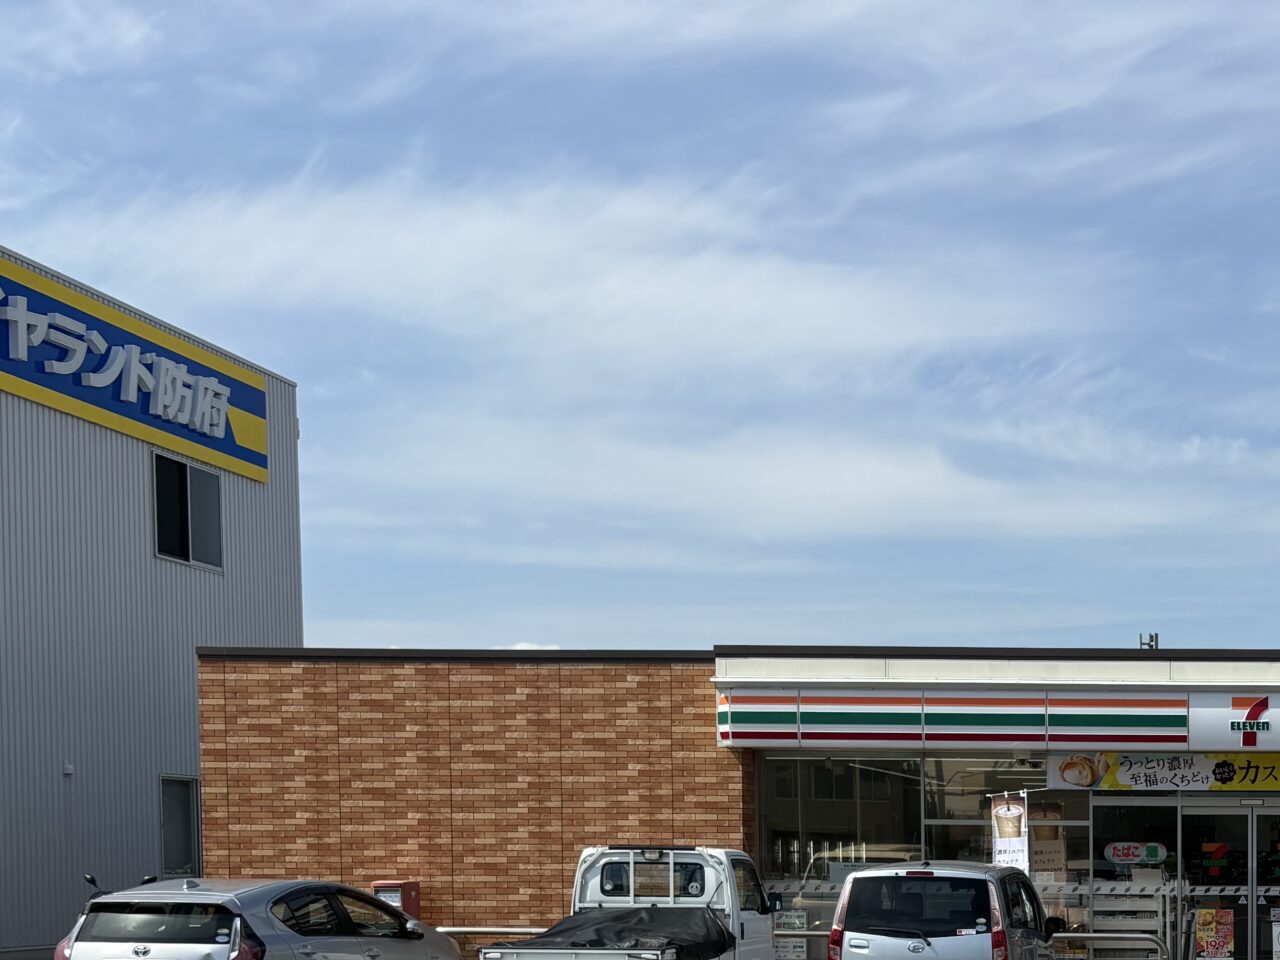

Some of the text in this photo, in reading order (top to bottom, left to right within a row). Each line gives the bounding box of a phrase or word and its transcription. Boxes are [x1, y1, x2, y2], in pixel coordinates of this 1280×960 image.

[0, 286, 231, 439] ヤランド防府
[1120, 756, 1196, 772] うっとり濃厚
[1130, 771, 1210, 788] 至福のくちどけ
